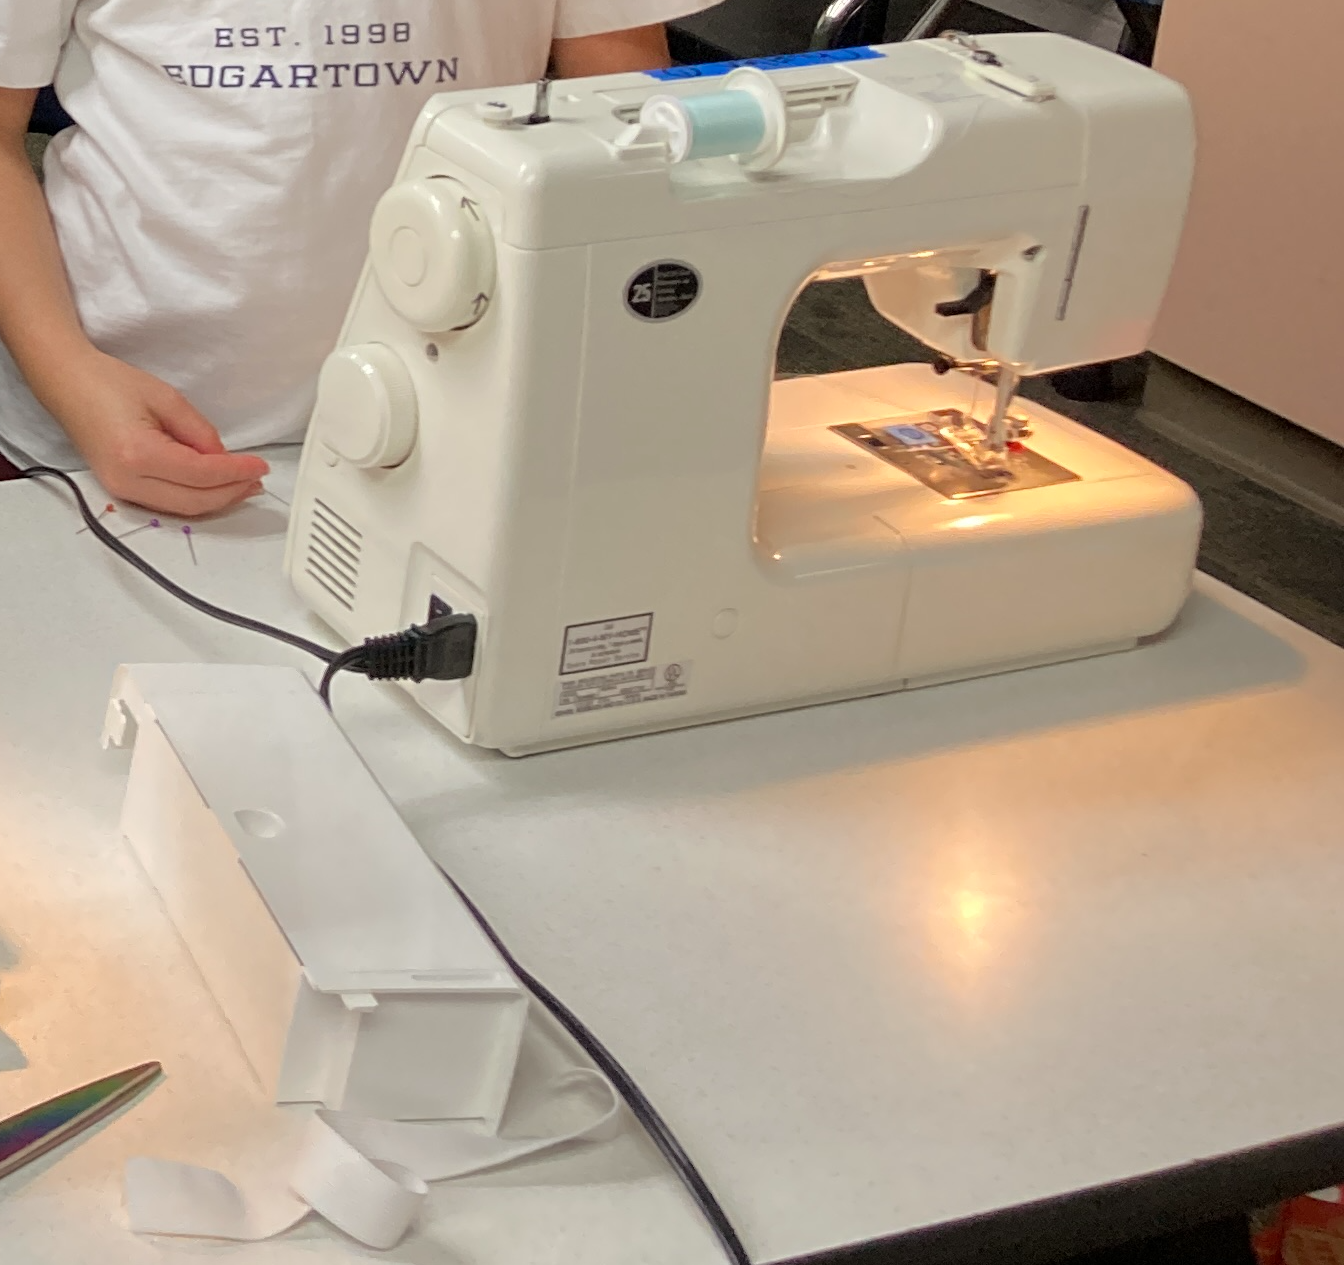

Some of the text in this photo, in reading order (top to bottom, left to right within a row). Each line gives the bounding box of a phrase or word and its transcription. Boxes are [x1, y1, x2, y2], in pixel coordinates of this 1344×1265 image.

[214, 21, 411, 48] EST. 1998
[162, 57, 459, 88] EDGARTOWN
[631, 283, 652, 303] 25
